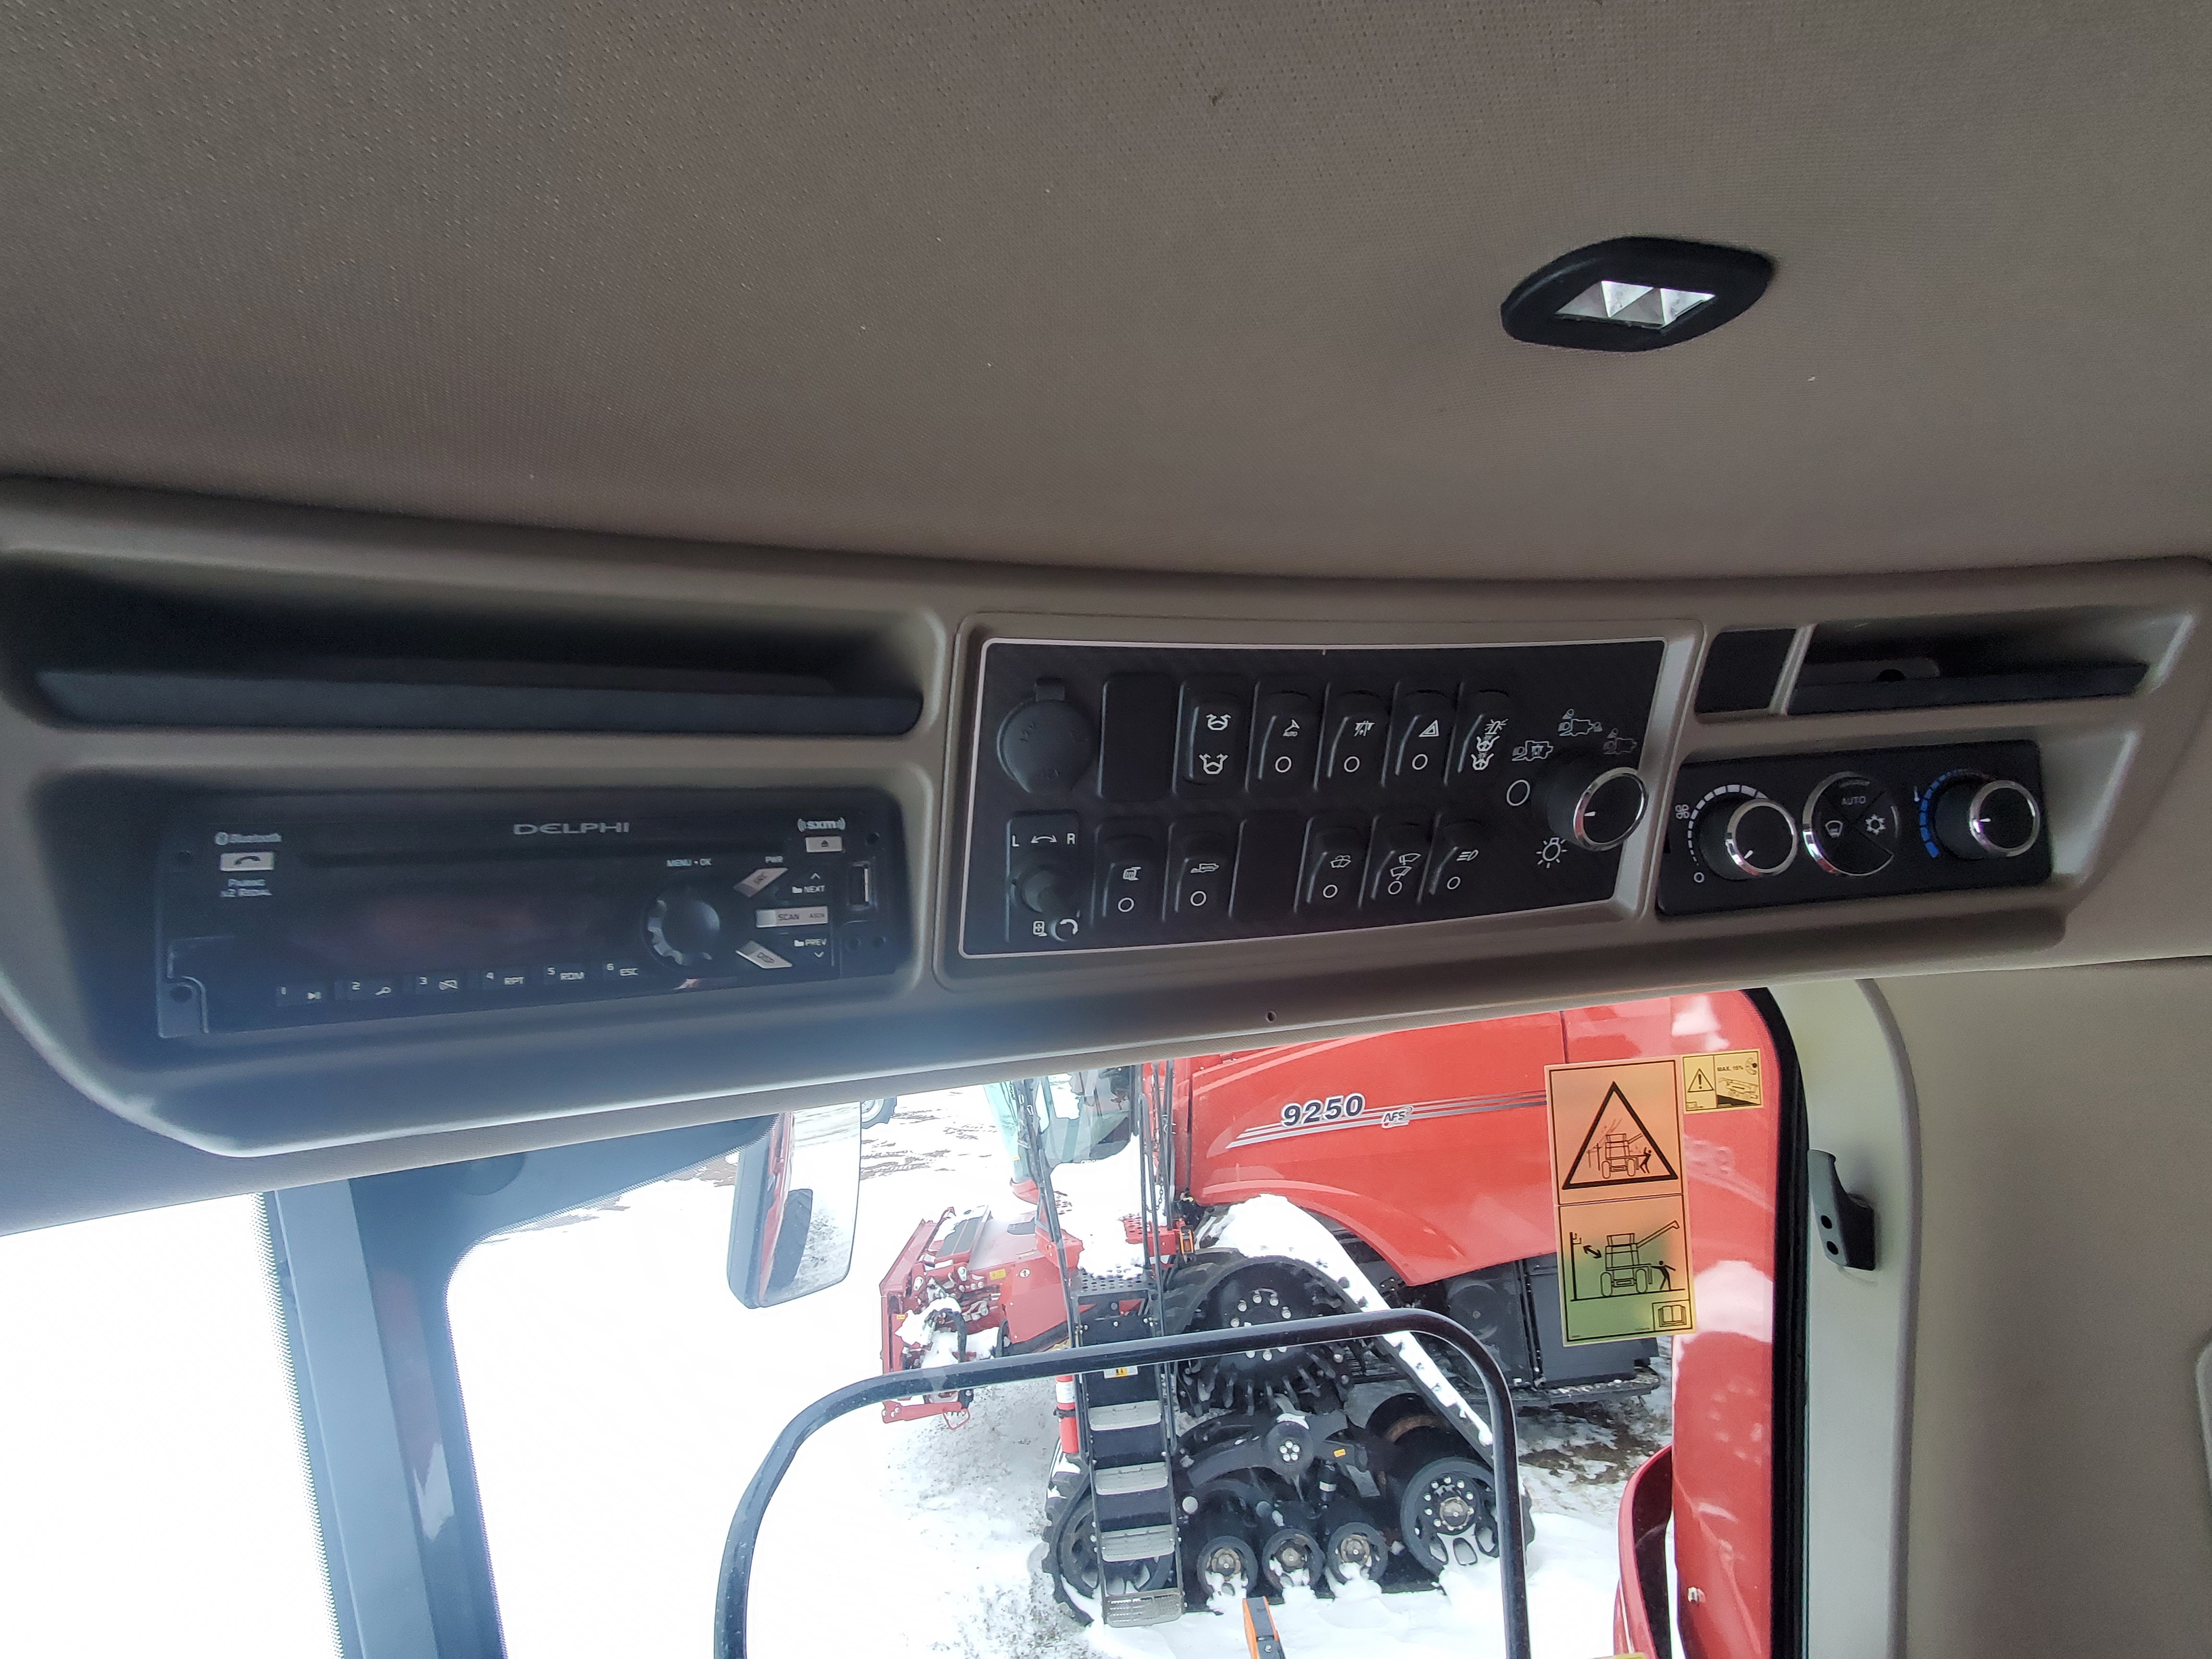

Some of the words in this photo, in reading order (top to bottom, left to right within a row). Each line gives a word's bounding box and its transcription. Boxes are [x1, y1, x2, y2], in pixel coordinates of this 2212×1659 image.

[1841, 795, 1866, 805] AUTO
[514, 822, 630, 835] DELPHI
[1011, 835, 1020, 847] L
[1067, 833, 1075, 845] R
[352, 982, 361, 990] 2
[419, 977, 428, 985] 3
[1282, 1092, 1365, 1127] 9250
[1383, 1110, 1405, 1122] AFS
